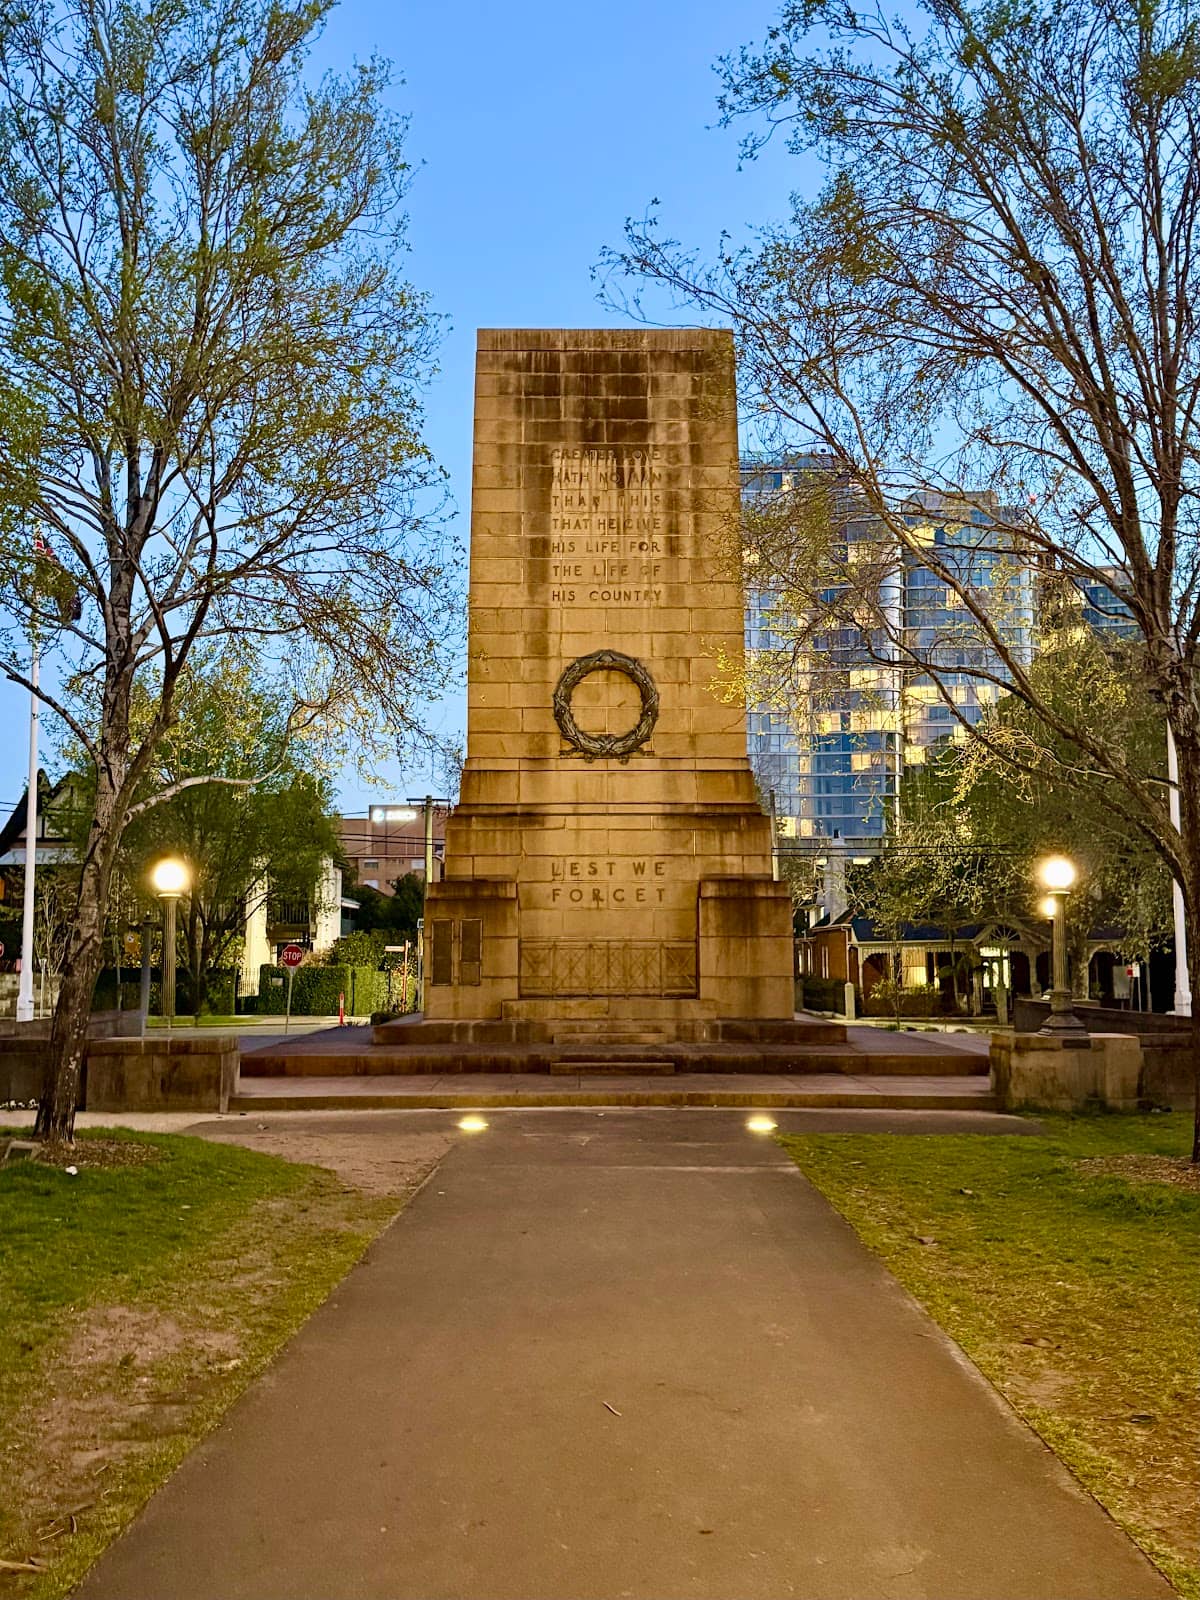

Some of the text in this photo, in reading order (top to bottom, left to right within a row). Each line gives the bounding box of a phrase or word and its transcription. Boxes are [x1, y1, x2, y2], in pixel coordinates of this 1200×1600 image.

[600, 472, 620, 483] NO
[618, 496, 661, 507] THIS
[552, 518, 661, 530] THAT HE GIVE
[552, 542, 661, 553] HIS LIFE FOR
[552, 565, 661, 577] THE LIFE OF
[552, 590, 662, 602] HIS COUNTRY
[552, 862, 665, 876] LEST WE
[552, 888, 665, 902] FORGET
[283, 951, 302, 961] STOP
